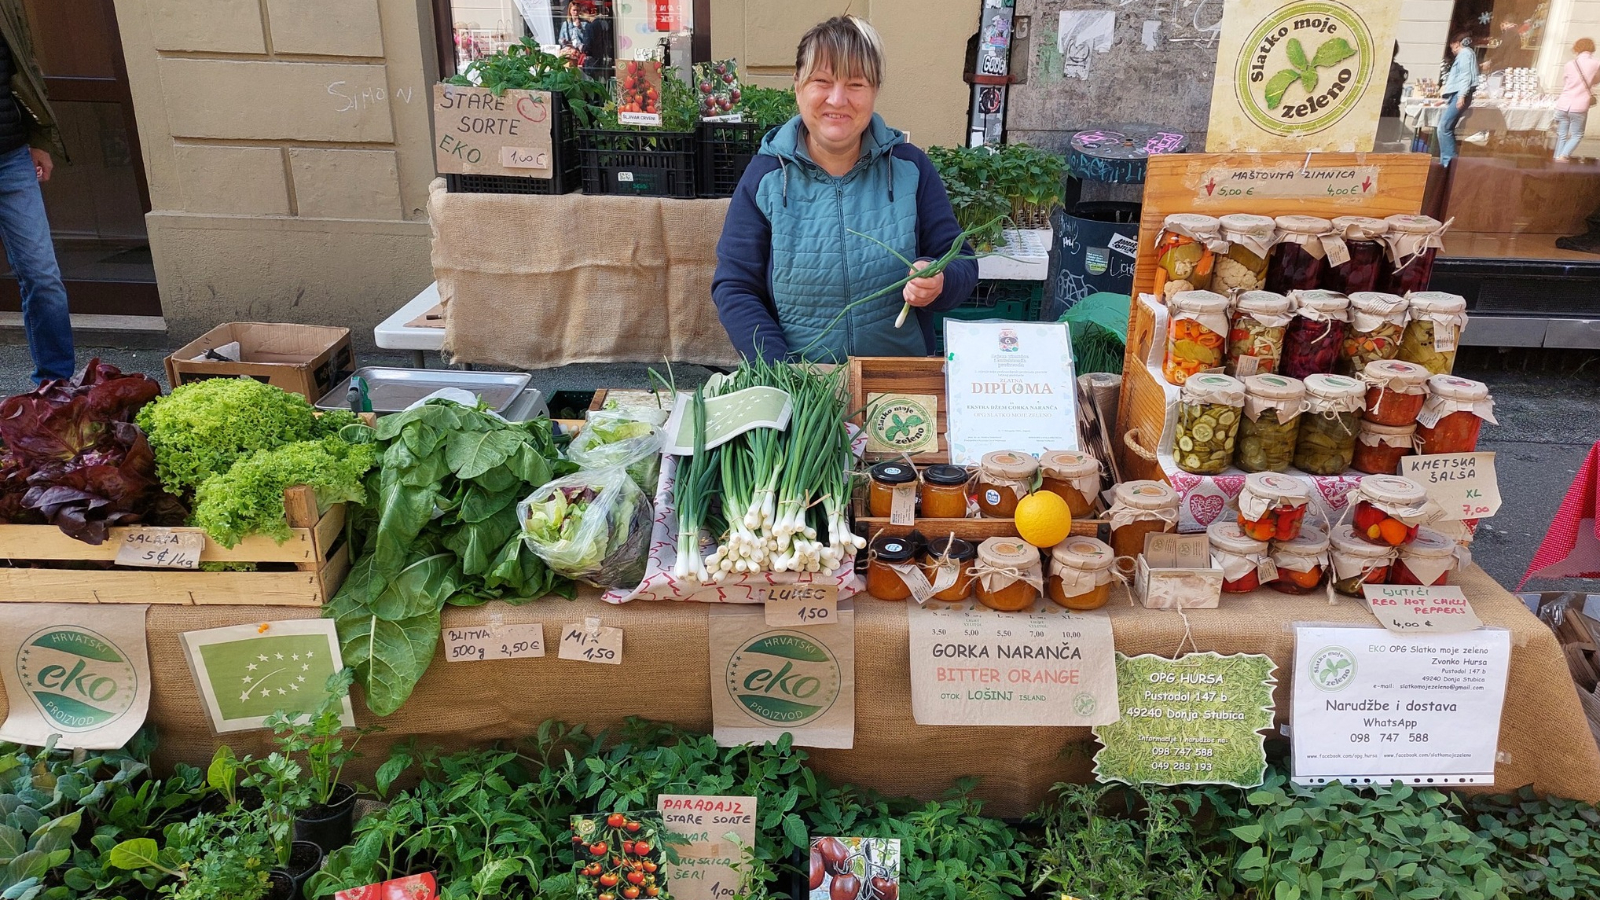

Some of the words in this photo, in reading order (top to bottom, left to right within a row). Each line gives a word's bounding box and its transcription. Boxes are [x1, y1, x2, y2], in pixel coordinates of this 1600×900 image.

[1251, 27, 1289, 83] Slatko
[1293, 17, 1338, 34] moje
[1281, 68, 1352, 119] zeleno
[440, 91, 506, 111] STARE
[457, 116, 520, 136] SORTE
[439, 134, 481, 164] EKO
[1231, 170, 1295, 180] MAŠTOVITA
[1303, 170, 1356, 179] ZIMNICA
[971, 382, 1053, 395] DIPLOMA
[895, 427, 925, 445] zeleno
[1411, 457, 1476, 471] KMETSKA
[1428, 467, 1476, 483] ŠALŠA
[1466, 489, 1482, 498] XL
[1462, 504, 1490, 516] 7,00
[768, 588, 827, 601] LUKEC
[1372, 598, 1397, 606] RED
[798, 606, 829, 622] 1,50
[1393, 619, 1420, 629] 4,00
[448, 630, 491, 641] BLITVA
[565, 629, 601, 645] MIX
[964, 629, 980, 637] 5,00
[1029, 630, 1045, 638] 7,00
[1062, 631, 1082, 639] 10,00
[51, 632, 108, 653] HRVATSKI
[764, 637, 817, 654] HRVATSKI
[1368, 644, 1386, 653] EKO
[1389, 645, 1408, 653] OPG
[1410, 645, 1437, 654] Slatko
[1439, 646, 1460, 655] moje
[1463, 646, 1489, 655] zeleno
[932, 643, 990, 659] GORKA
[997, 641, 1082, 660] NARANČA
[1431, 657, 1460, 666] Zvonko
[1463, 658, 1488, 666] Hursa
[37, 658, 118, 702] eko
[743, 660, 821, 699] eko
[937, 667, 1000, 683] BITTER
[1007, 669, 1080, 685] ORANGE
[1149, 672, 1176, 683] OPG
[1180, 673, 1224, 684] HURSA
[1326, 668, 1351, 687] zeleno
[967, 688, 1014, 701] LOŠINJ
[1019, 694, 1047, 702] ISLAND
[1144, 690, 1190, 701] Pustodol
[1195, 692, 1217, 702] 147
[1220, 692, 1228, 702] b
[750, 701, 803, 720] PROIZVOD
[1325, 699, 1390, 712] Narudžbe
[1396, 700, 1400, 711] i
[1406, 700, 1457, 712] dostava
[45, 701, 95, 726] PROIZVOD
[1126, 707, 1163, 718] 49240
[1167, 708, 1198, 721] Donja
[1203, 709, 1245, 720] Stubica
[1363, 718, 1418, 730] WhatsApp
[1350, 733, 1370, 743] 098
[1380, 733, 1400, 743] 747
[1408, 733, 1429, 743] 588
[1151, 747, 1170, 756] 098
[1173, 747, 1192, 756] 747
[1195, 748, 1213, 757] 588
[1151, 762, 1169, 771] 049
[1173, 762, 1191, 771] 283
[1195, 762, 1212, 772] 193
[663, 799, 744, 815] PARADAJZ
[665, 814, 703, 825] STARE
[712, 815, 751, 824] SORTE
[673, 868, 705, 880] ŠERI
[711, 881, 735, 899] 1,00
